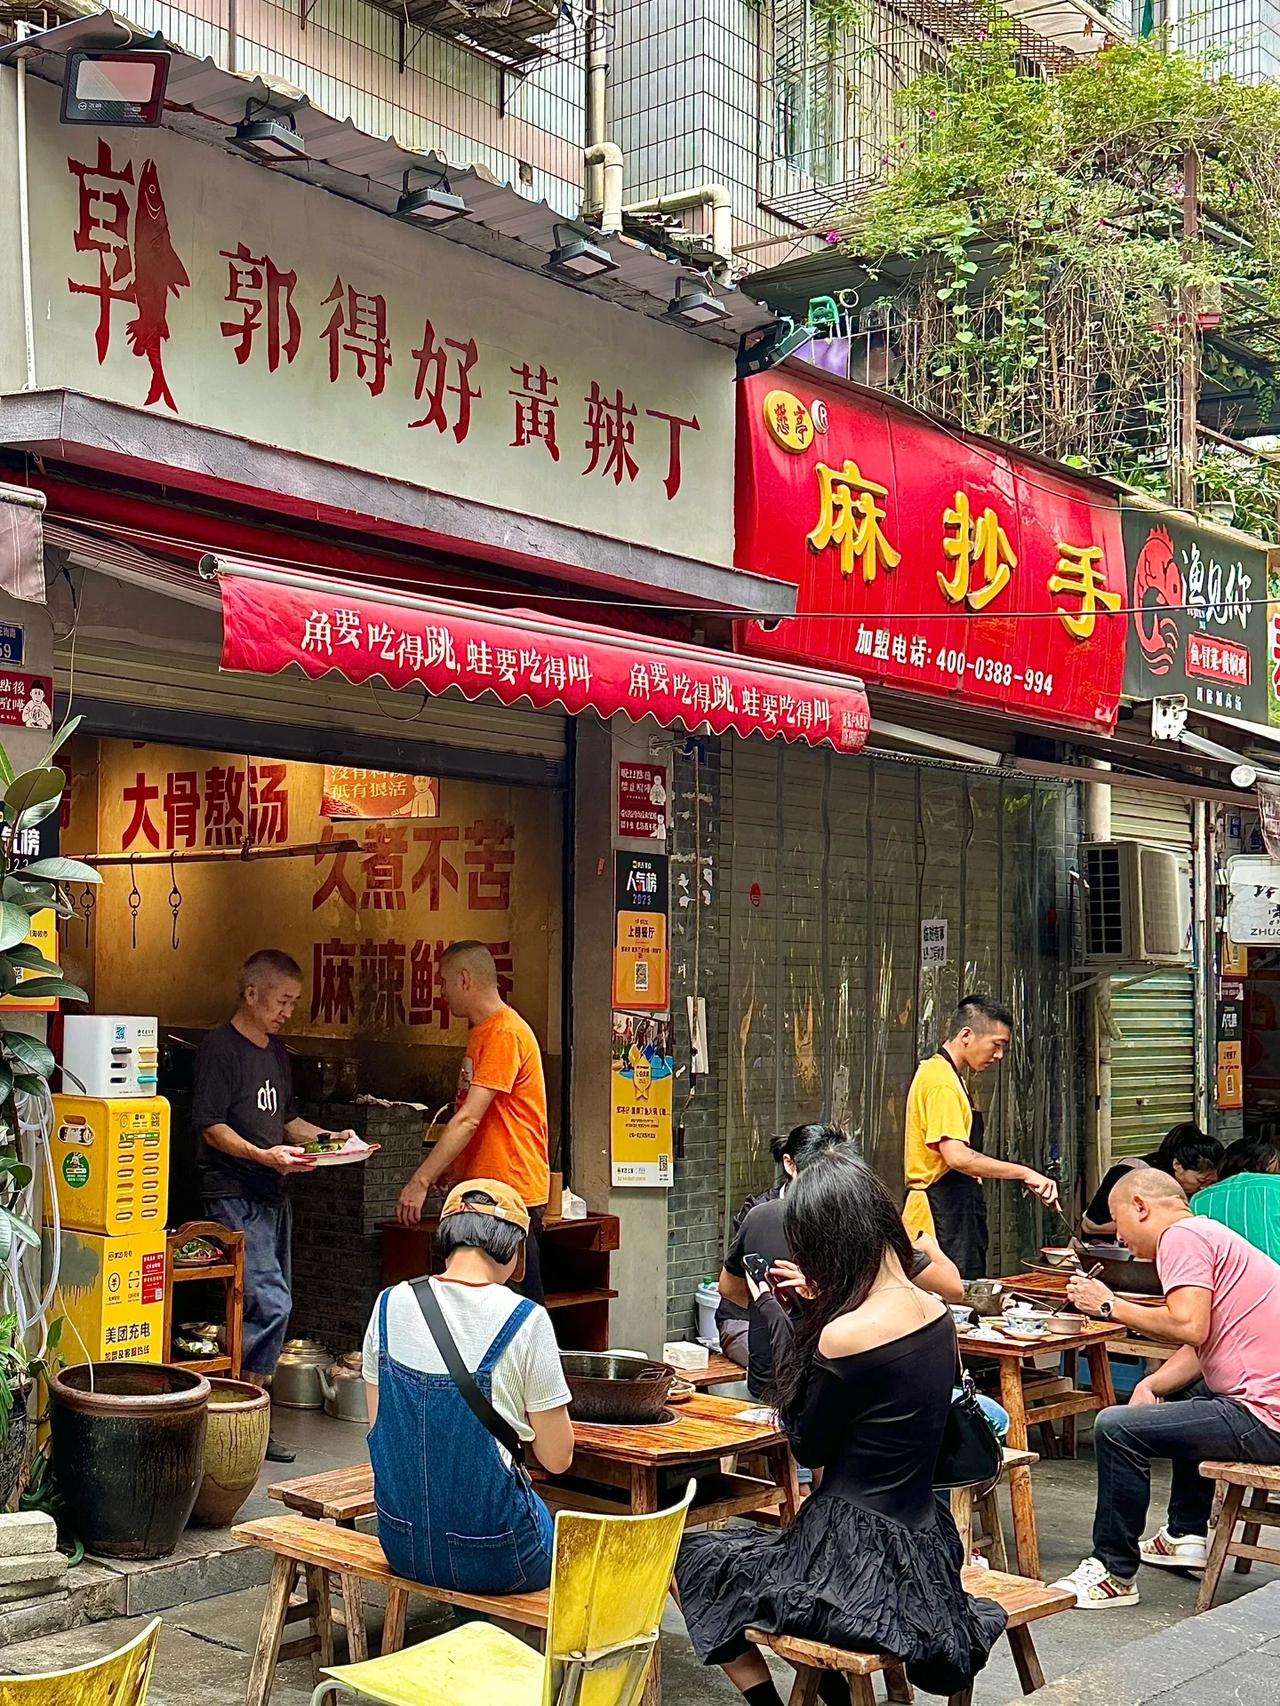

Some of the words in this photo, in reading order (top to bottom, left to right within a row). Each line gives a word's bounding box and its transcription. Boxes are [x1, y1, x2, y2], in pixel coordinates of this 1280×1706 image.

[806, 459, 1122, 640] 麻抄手
[122, 764, 289, 851] 大骨熬汤
[626, 870, 657, 893] 人气榜
[106, 1322, 151, 1344] 美团充电
